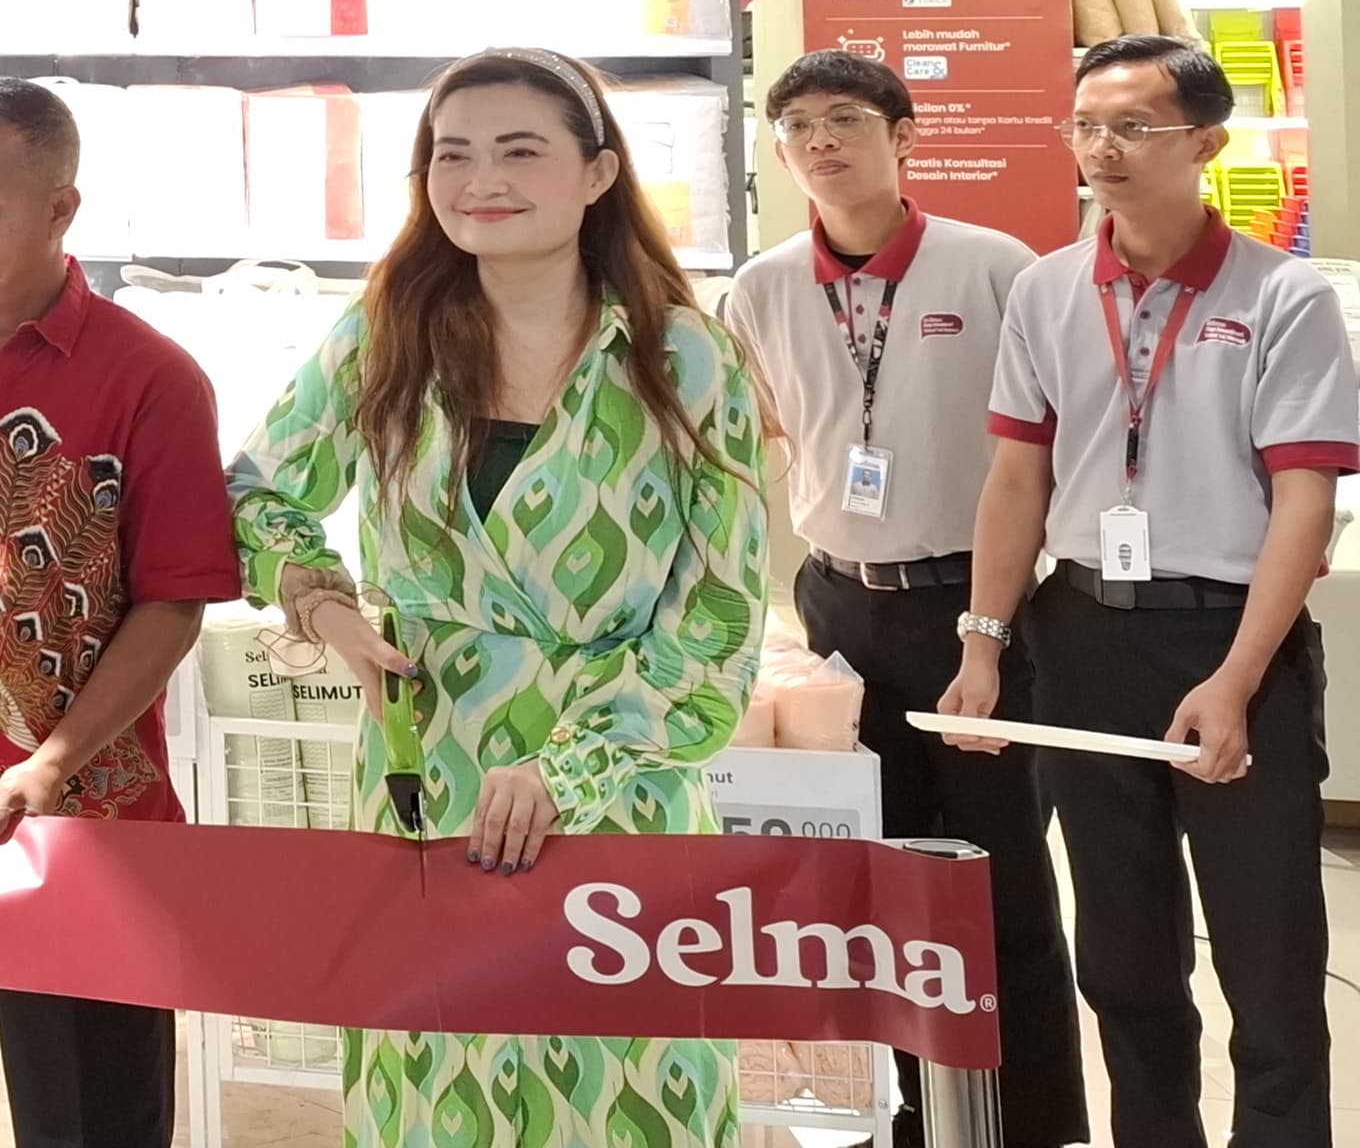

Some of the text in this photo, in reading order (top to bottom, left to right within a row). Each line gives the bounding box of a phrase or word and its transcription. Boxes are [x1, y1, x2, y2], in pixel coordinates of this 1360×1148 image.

[903, 29, 980, 39] Lebih mudah
[903, 42, 957, 51] merawat
[914, 103, 946, 112] icilan
[968, 116, 996, 126] tanpa
[998, 116, 1024, 124] Kartu
[1025, 115, 1053, 124] Kredit
[940, 127, 952, 135] 24
[907, 158, 1007, 168] Gratis Konsultasi
[907, 171, 948, 180] Desain
[293, 685, 363, 700] SELIMUT
